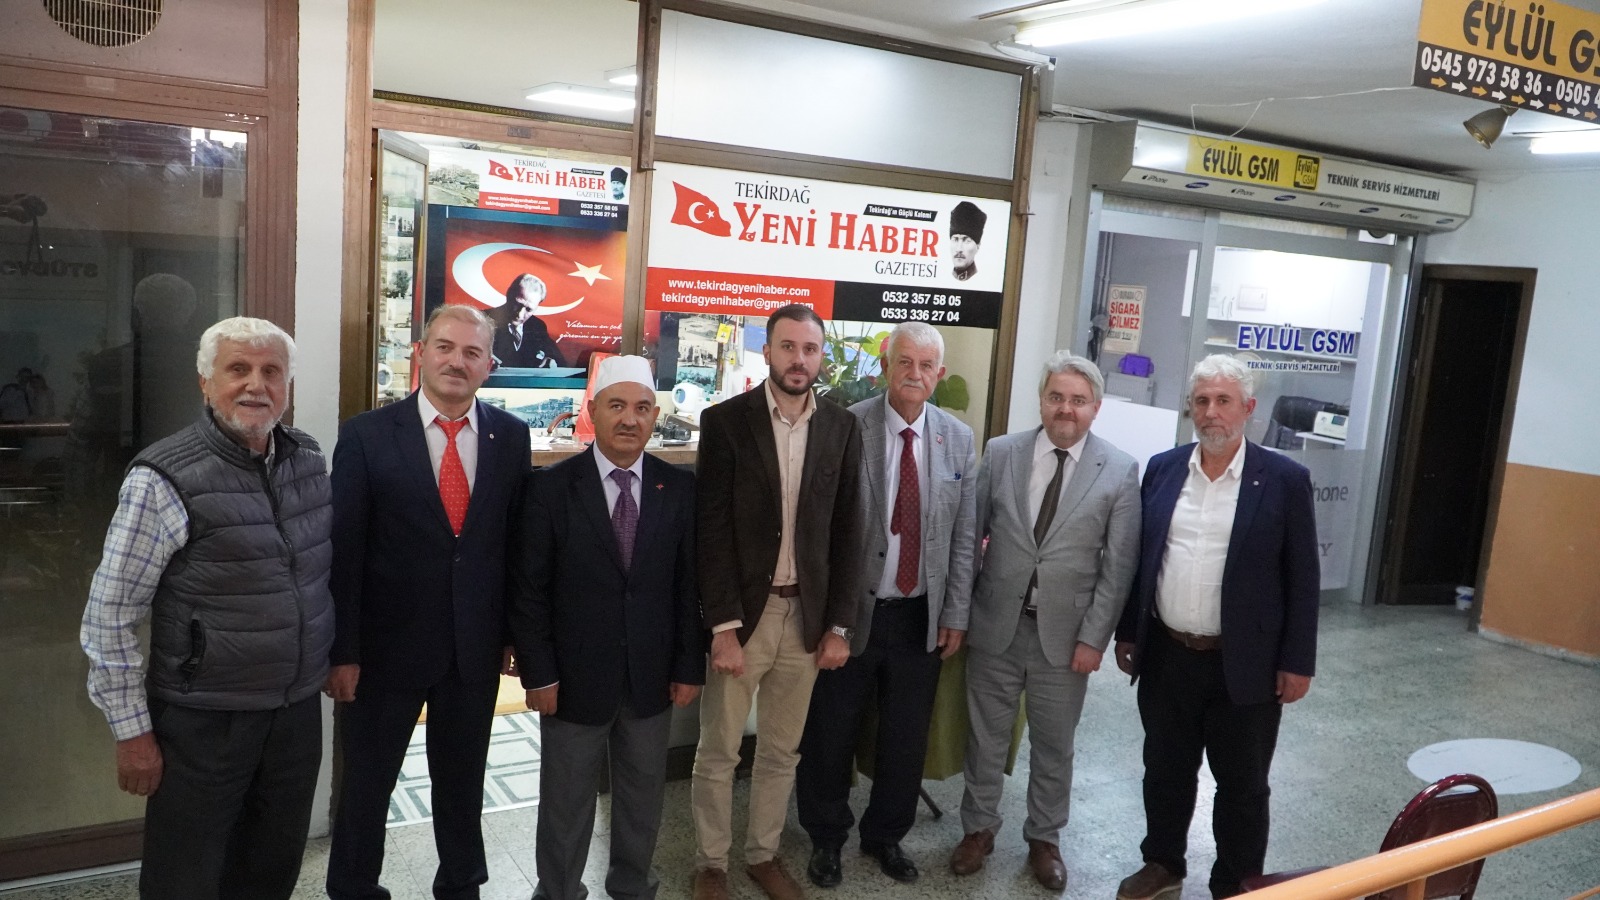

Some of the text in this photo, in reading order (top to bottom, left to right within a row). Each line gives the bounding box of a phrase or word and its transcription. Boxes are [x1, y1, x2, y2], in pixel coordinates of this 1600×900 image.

[1463, 0, 1557, 66] EYLÜL
[1421, 47, 1463, 77] 0545
[1467, 58, 1497, 85] 973
[1500, 66, 1521, 90] 58
[1523, 71, 1542, 96] 36
[1556, 79, 1592, 107] 0505
[1203, 145, 1280, 182] EYLÜL GSM
[514, 166, 606, 191] YENİ HABER
[1327, 173, 1440, 201] TEKNİK SERVİS HİZMETLERİ
[735, 180, 811, 204] TEKİRDAĞ
[733, 201, 939, 258] YENİ HABER
[874, 260, 938, 278] GAZETESİ
[668, 278, 810, 297] www.tekirdagyenihaber.com
[882, 291, 961, 307] 0532 357 58 05
[661, 291, 814, 311] tekirdagyenihaber@gmailm
[1110, 301, 1140, 316] SİGARA
[881, 307, 960, 323] 0533 336 27 04
[1238, 323, 1355, 354] EYLÜL GSM
